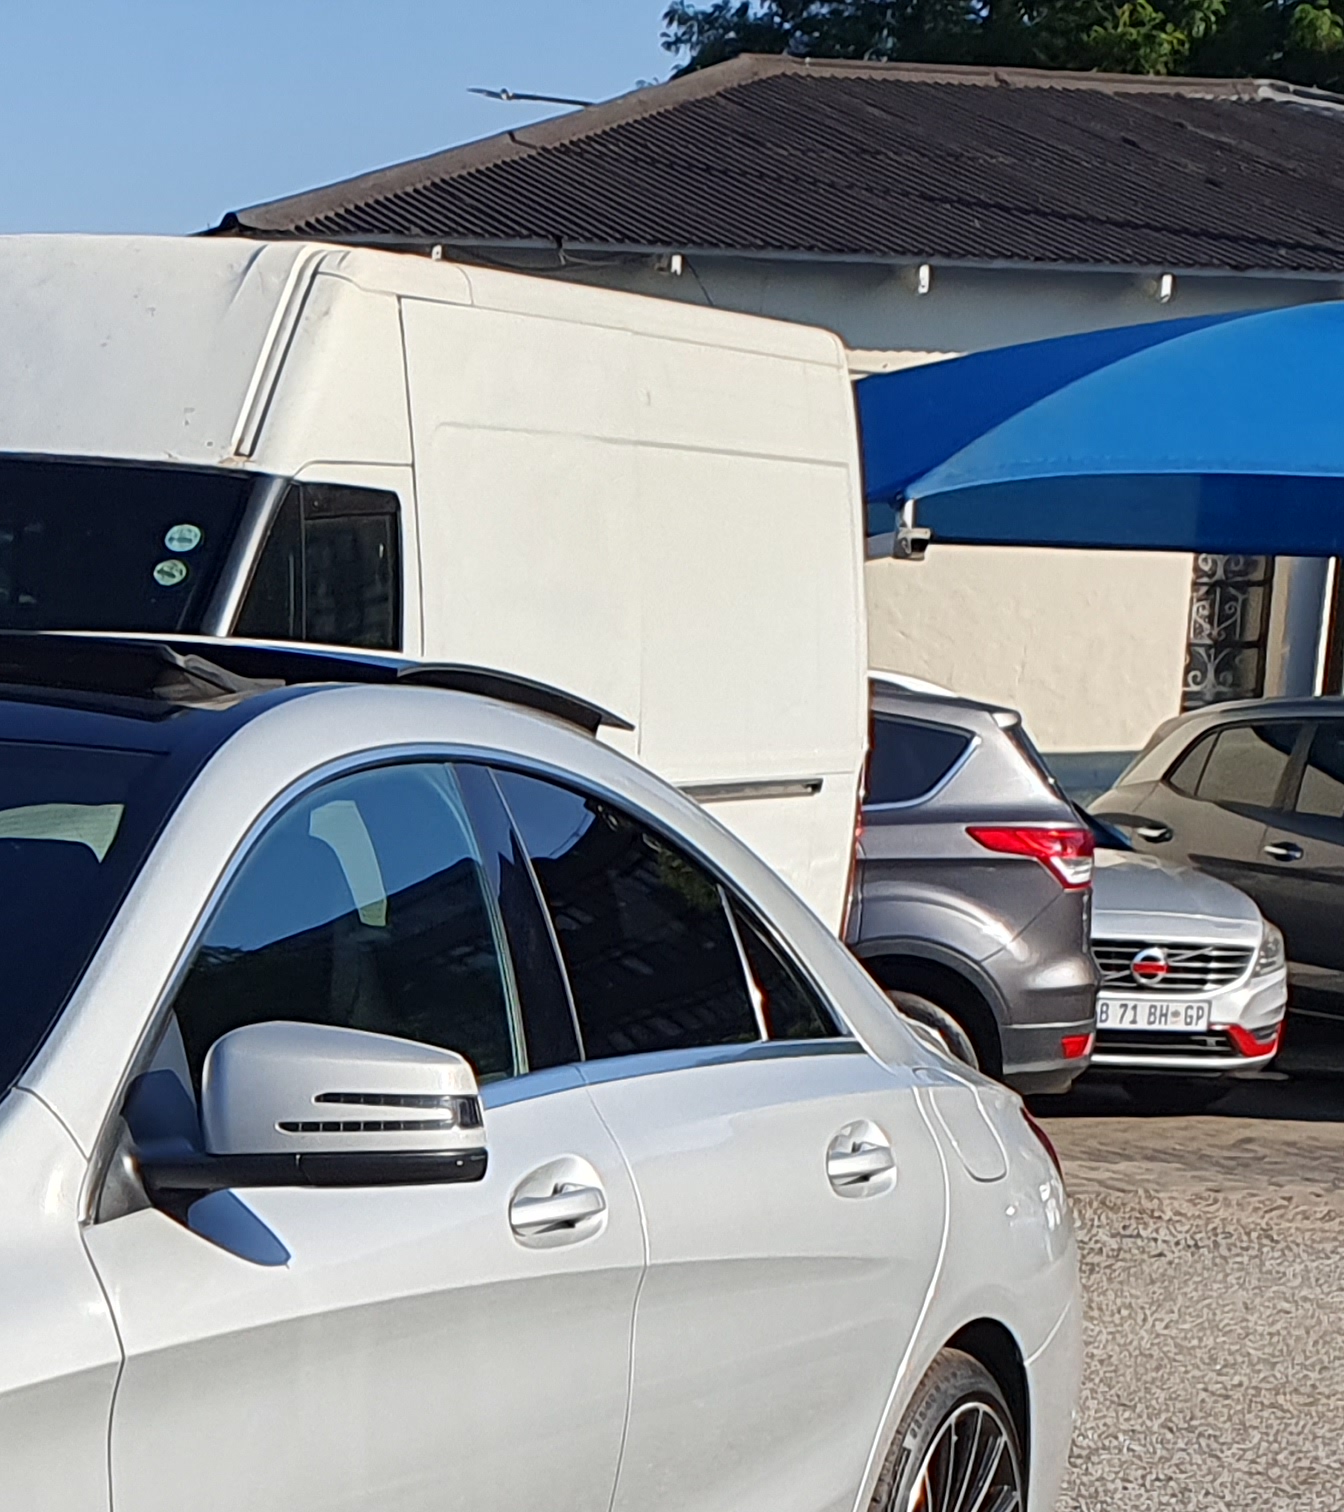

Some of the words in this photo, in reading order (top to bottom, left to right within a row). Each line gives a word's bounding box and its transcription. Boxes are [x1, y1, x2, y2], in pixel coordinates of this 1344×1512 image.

[1118, 1003, 1139, 1025] 71
[1147, 1004, 1170, 1026] BH
[1184, 1004, 1205, 1026] GP
